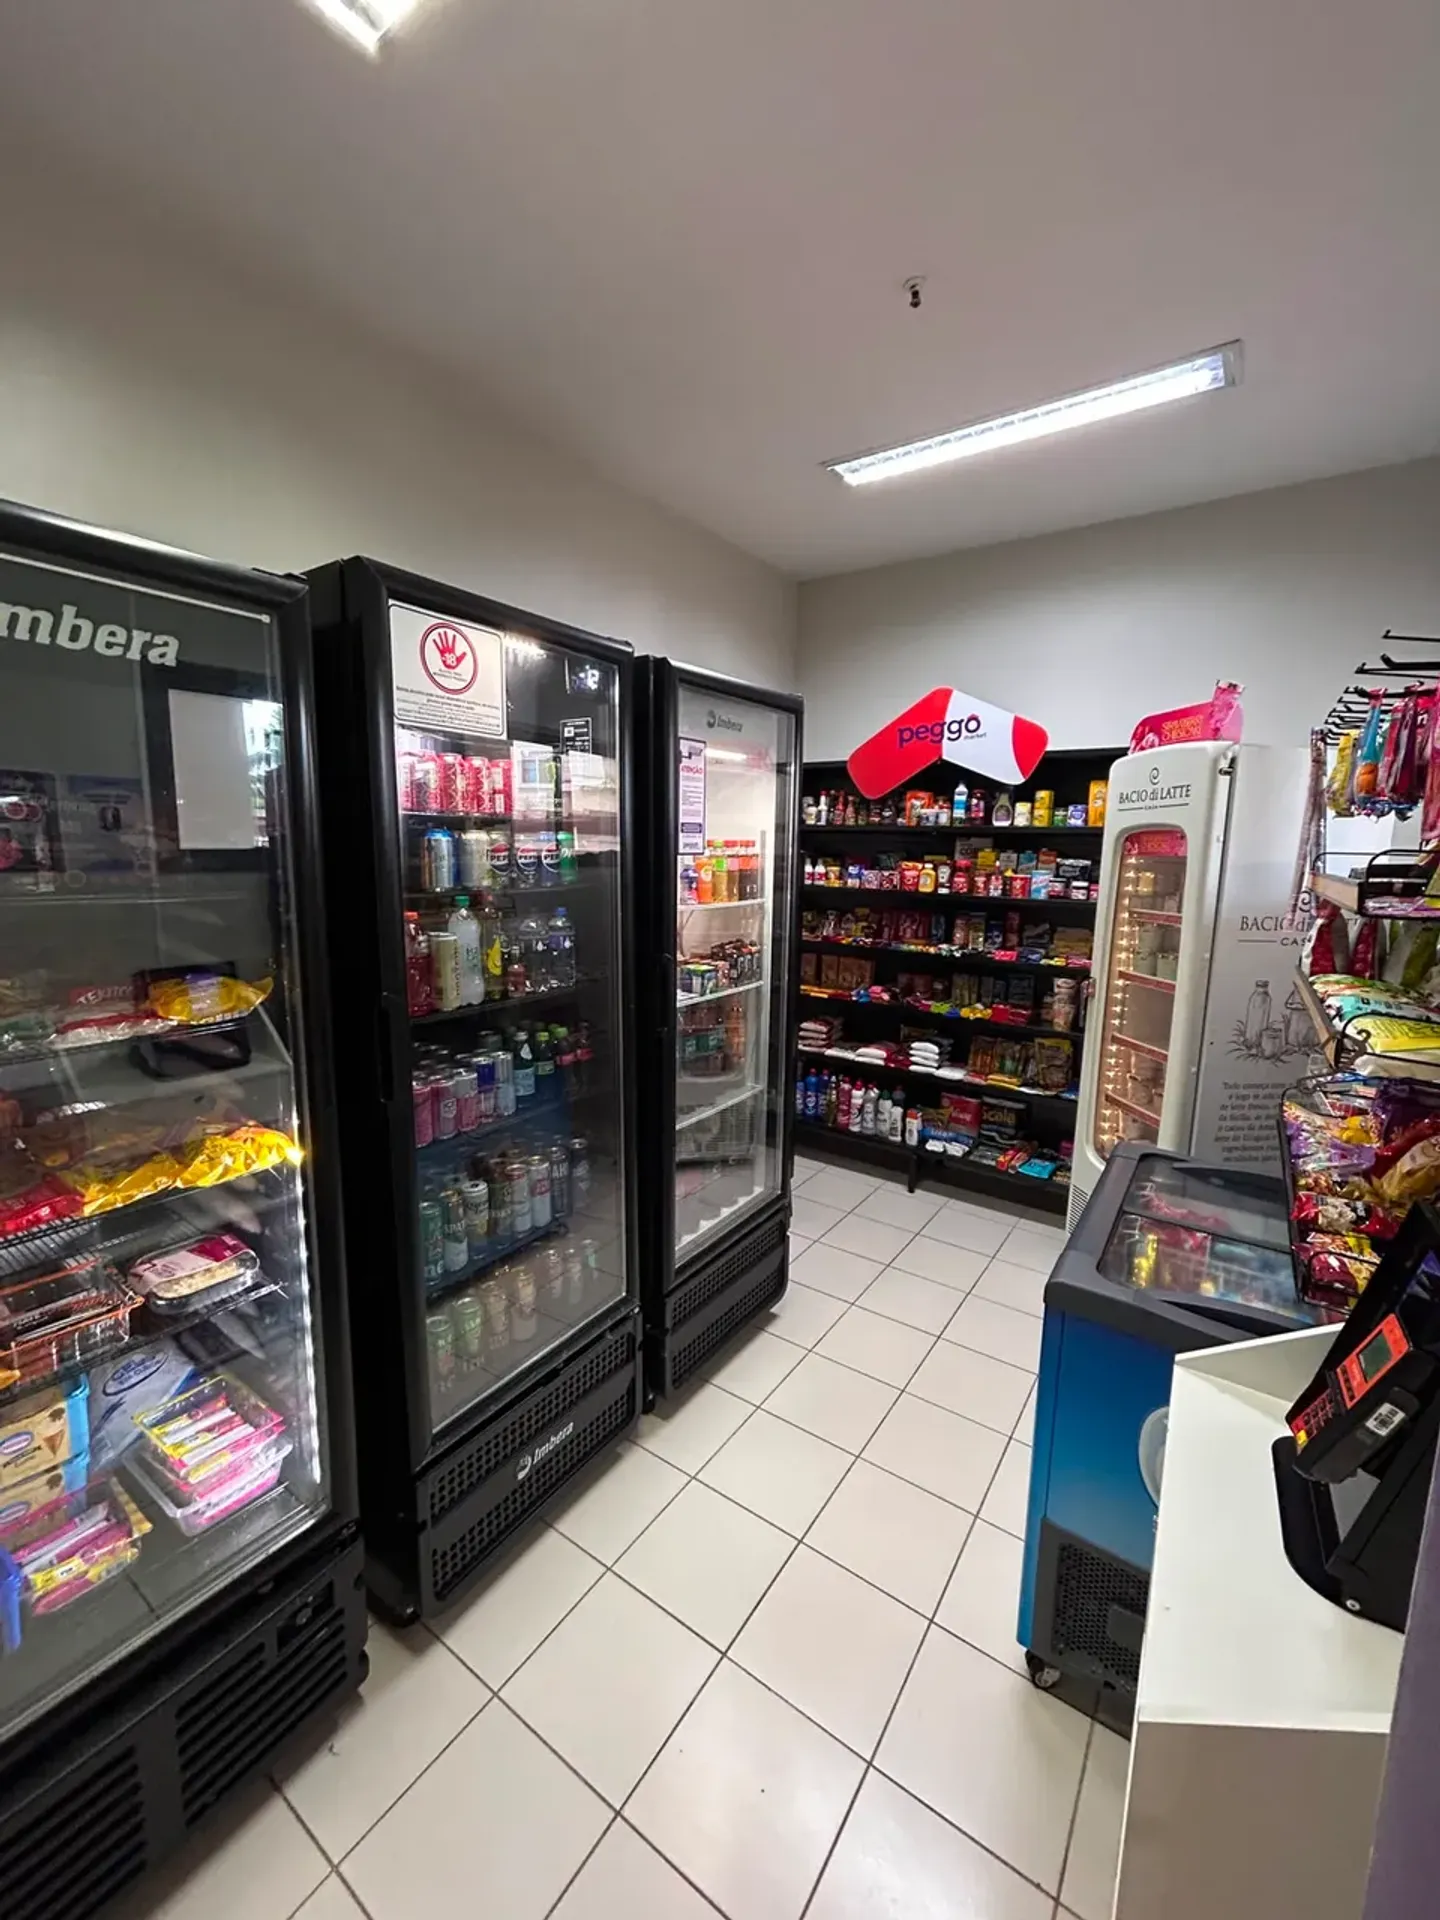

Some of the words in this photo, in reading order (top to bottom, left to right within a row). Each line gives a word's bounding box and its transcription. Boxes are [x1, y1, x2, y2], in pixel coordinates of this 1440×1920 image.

[0, 601, 181, 667] mbera
[1119, 788, 1149, 804] BACIO
[1149, 788, 1159, 801] di
[1160, 784, 1191, 800] LATTE
[1280, 937, 1312, 946] CAS
[533, 1422, 574, 1465] Imbera
